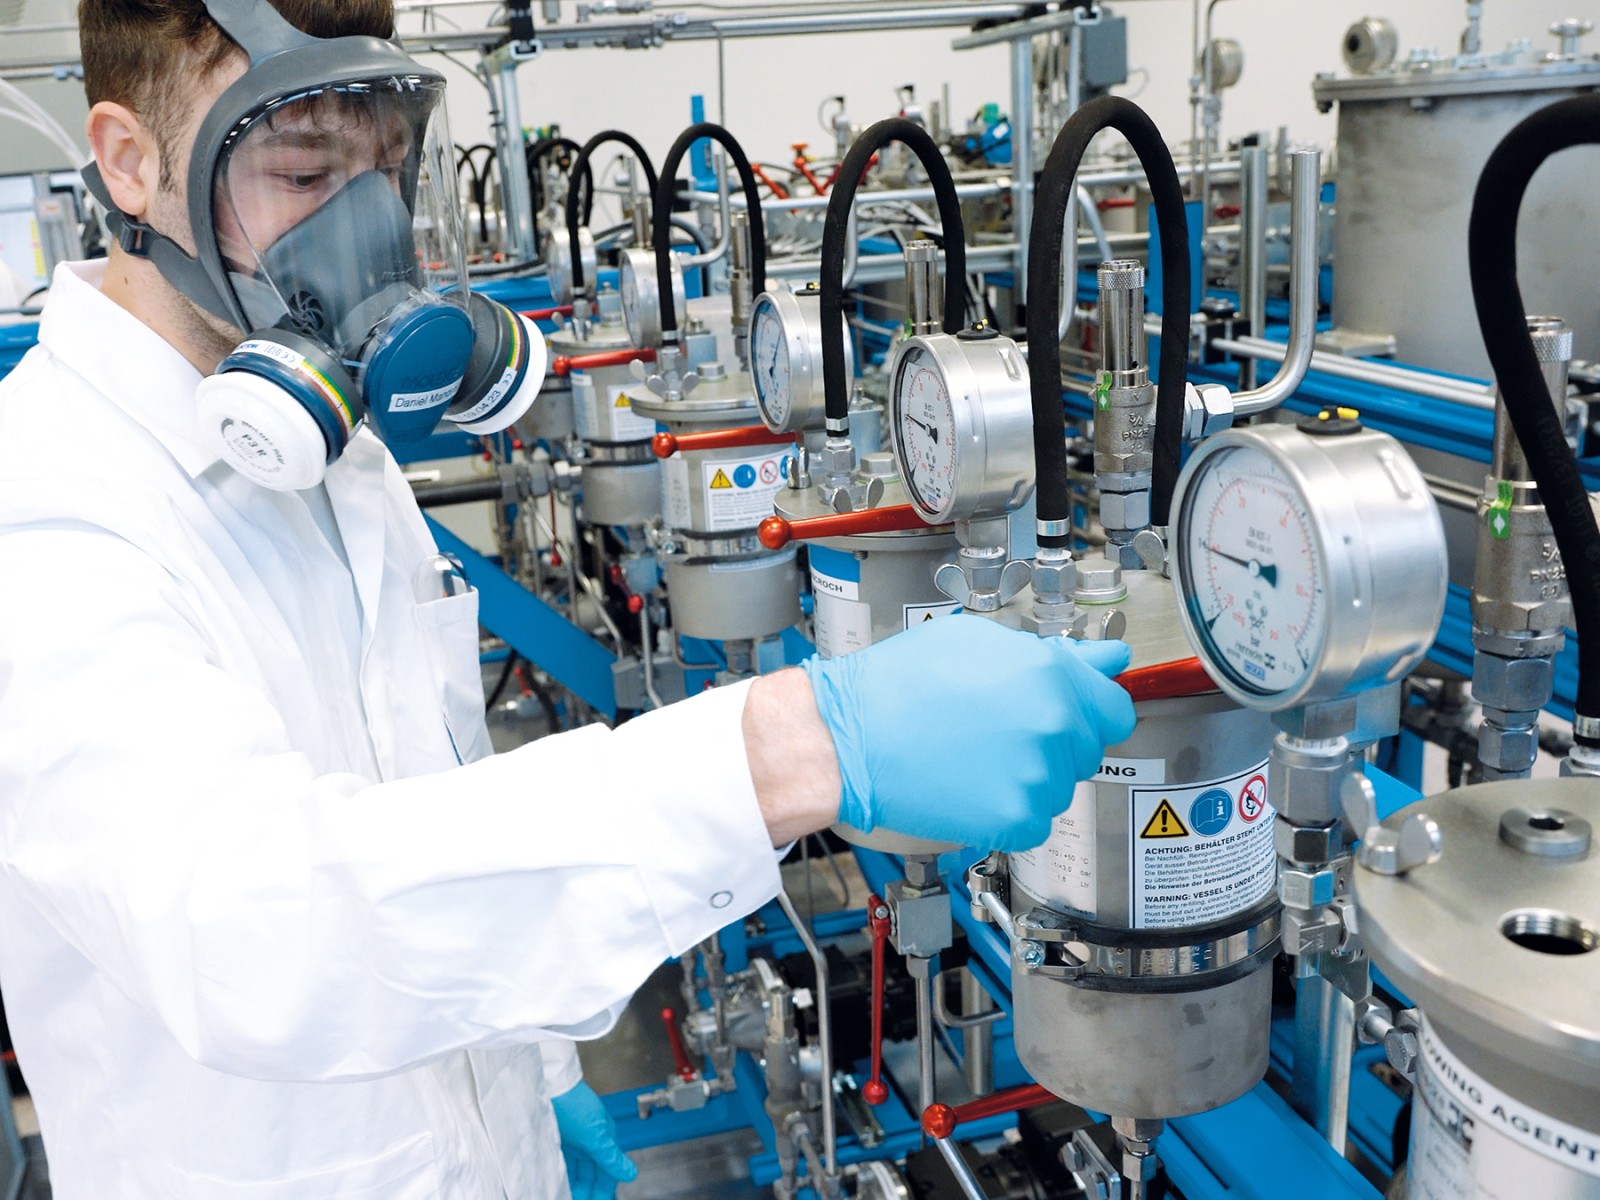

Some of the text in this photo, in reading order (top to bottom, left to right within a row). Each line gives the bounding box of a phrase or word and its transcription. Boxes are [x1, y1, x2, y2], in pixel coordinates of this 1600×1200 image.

[394, 396, 429, 408] Daniel
[463, 389, 502, 419] 19.04.23
[1059, 817, 1075, 827] 2022
[1144, 846, 1193, 855] ACHTUNG:
[1194, 836, 1235, 851] BEHÄLTER
[1236, 827, 1256, 840] STEHT
[1080, 869, 1092, 877] bar
[1144, 894, 1191, 903] WARNING:
[1193, 887, 1224, 899] VESSEL
[1225, 883, 1233, 892] IS
[1233, 873, 1256, 889] UNDER
[1158, 882, 1190, 890] Hinweise
[1202, 901, 1229, 911] operation
[1197, 911, 1216, 919] vessel
[1490, 1104, 1600, 1163] AGENT
